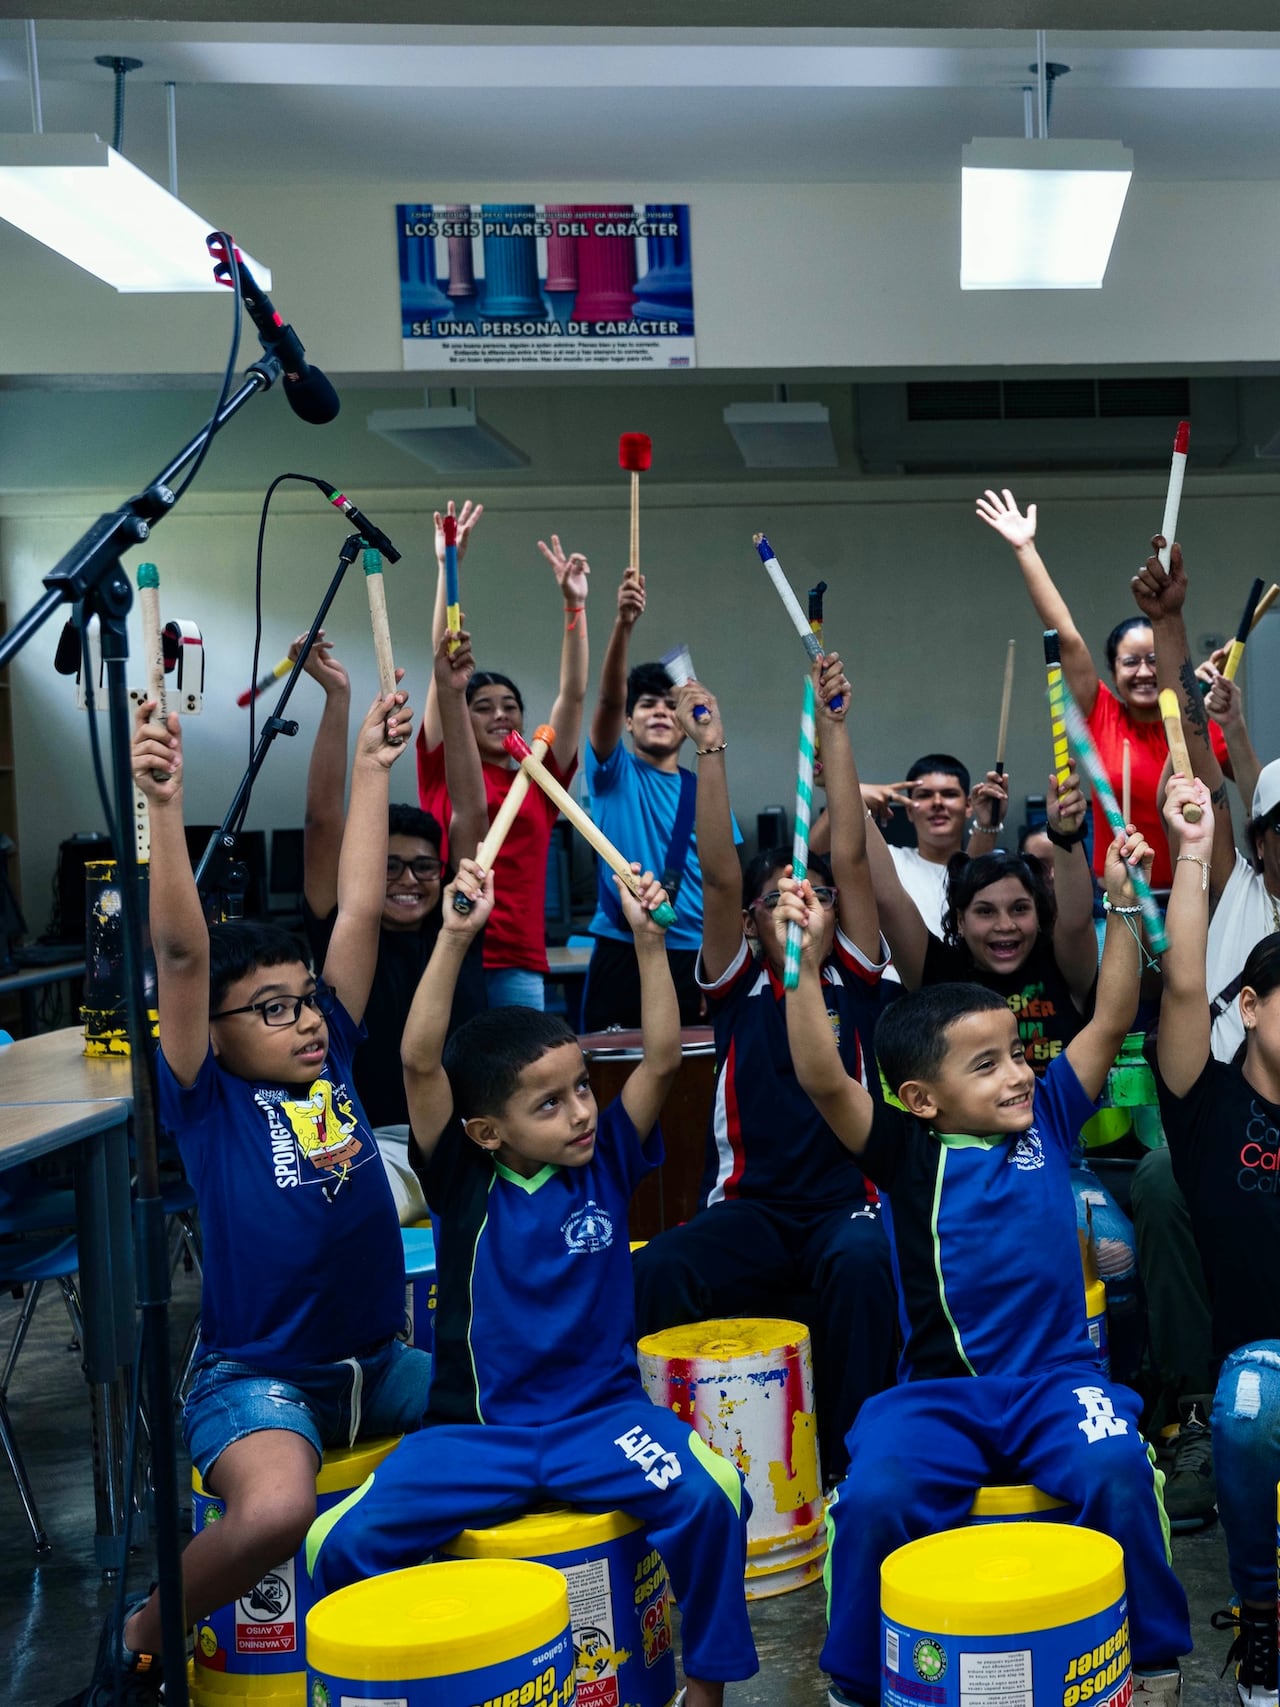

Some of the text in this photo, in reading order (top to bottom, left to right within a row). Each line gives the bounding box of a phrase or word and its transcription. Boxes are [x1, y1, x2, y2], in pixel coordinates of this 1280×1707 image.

[405, 220, 679, 237] LOS SEIS PILARES DEL CARÁCTER
[412, 319, 679, 336] SÉ UNA PERSONA DE CARÁCTER
[245, 1625, 273, 1635] AVISO
[238, 1640, 281, 1650] WARNING
[532, 1643, 564, 1667] Gallons
